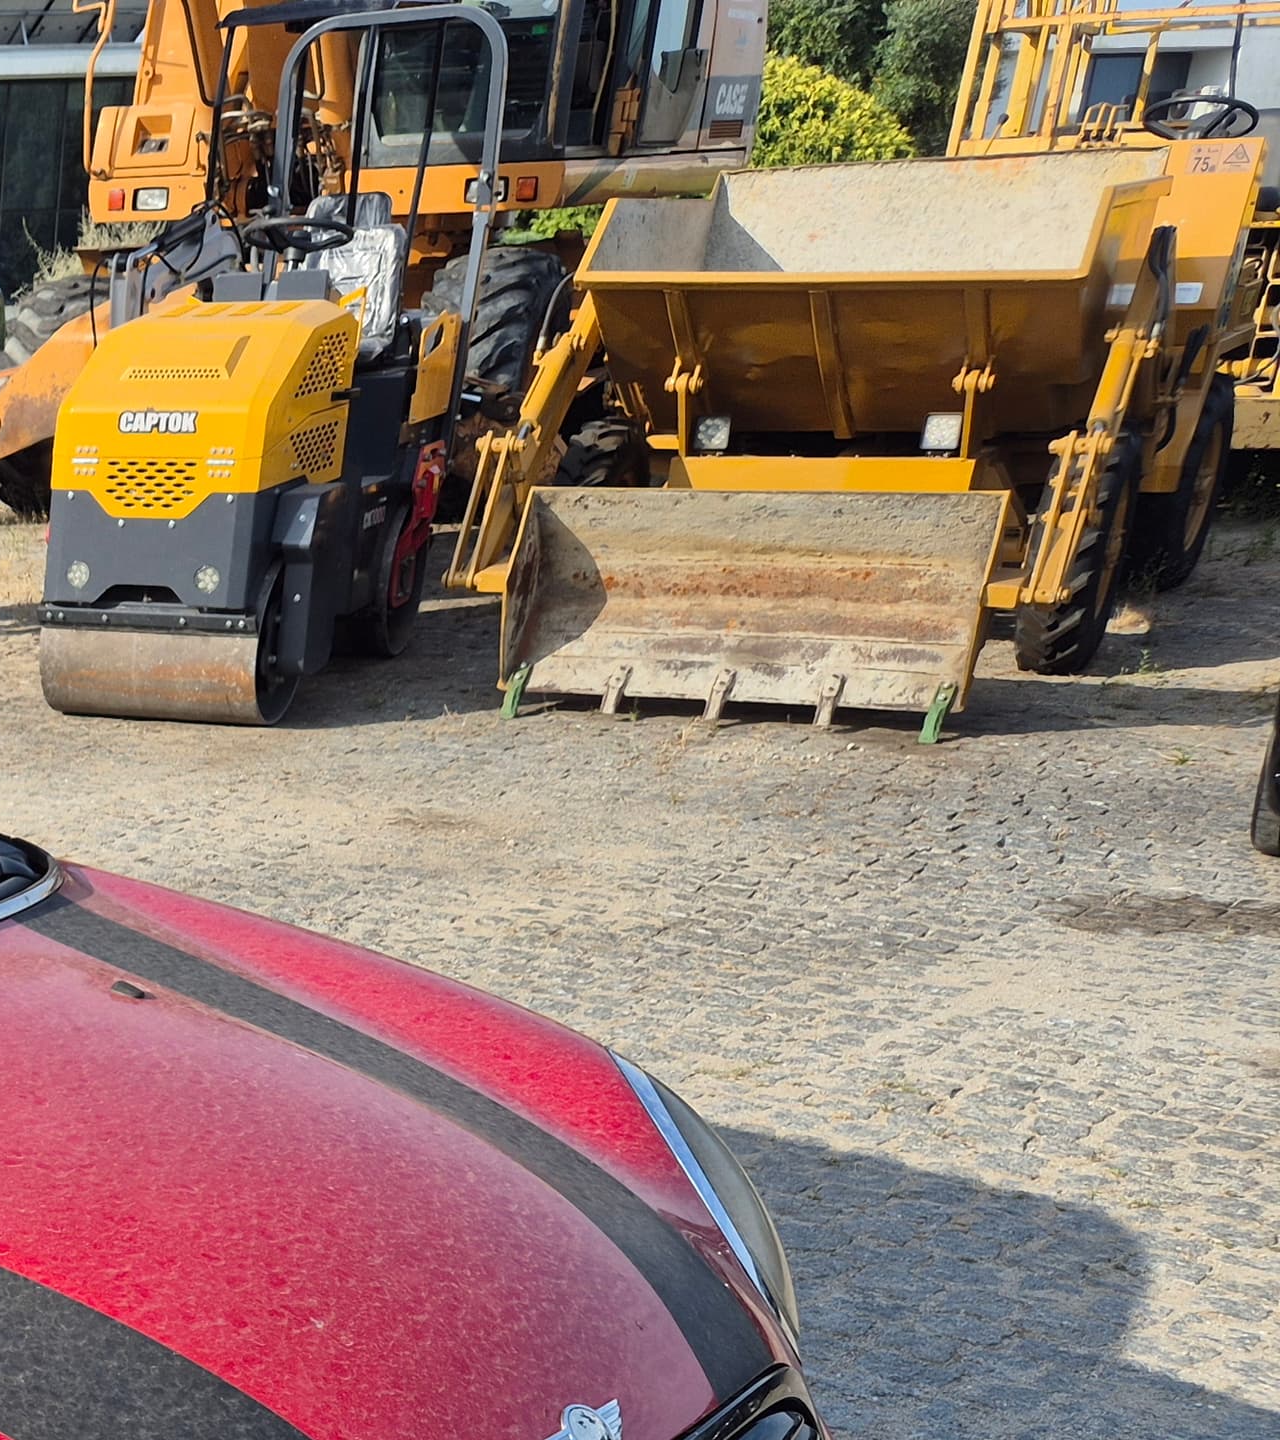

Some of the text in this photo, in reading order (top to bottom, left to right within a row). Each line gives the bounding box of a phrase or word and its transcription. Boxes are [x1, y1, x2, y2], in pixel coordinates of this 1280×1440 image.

[715, 83, 749, 115] CASE
[1191, 156, 1211, 173] 75
[118, 411, 198, 433] CAPTOK
